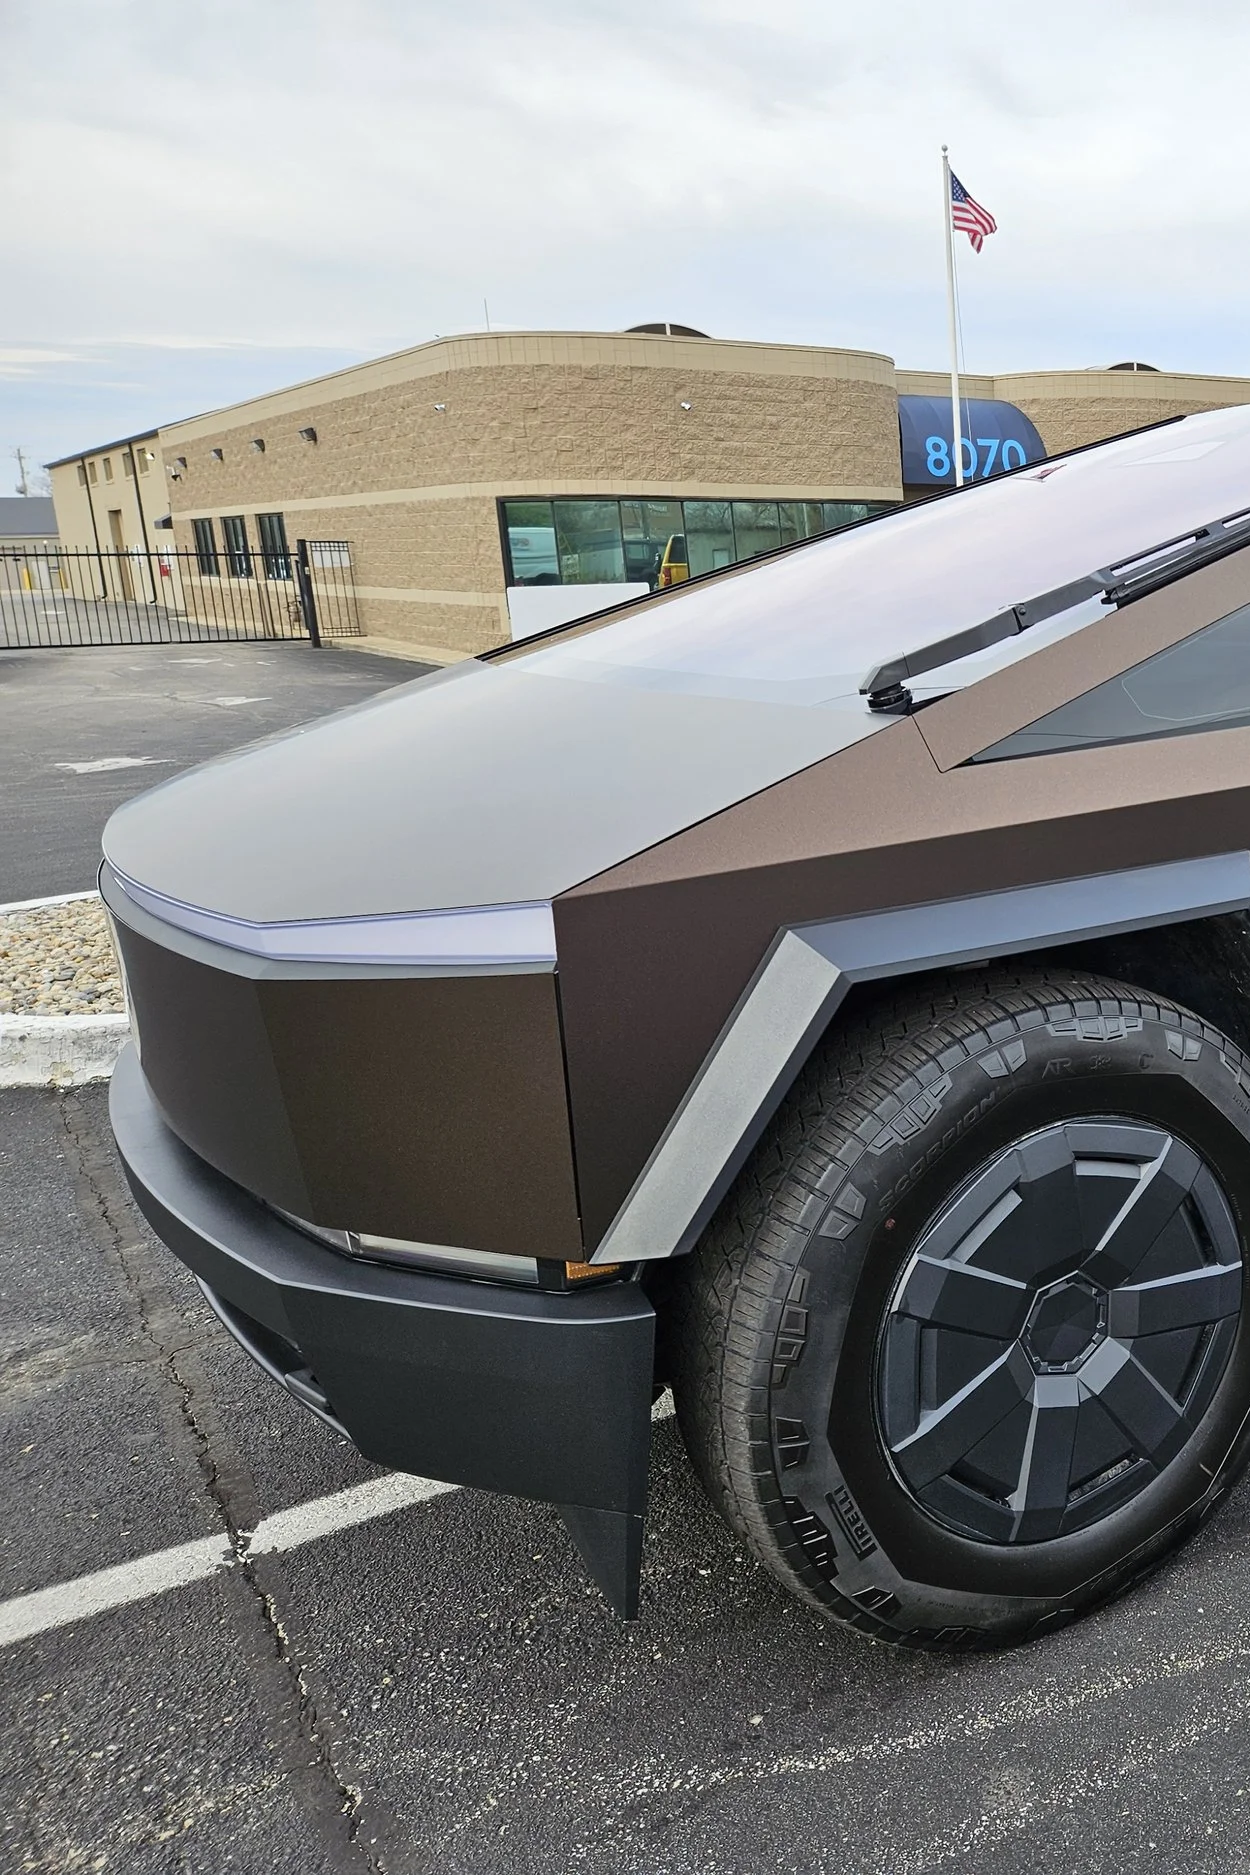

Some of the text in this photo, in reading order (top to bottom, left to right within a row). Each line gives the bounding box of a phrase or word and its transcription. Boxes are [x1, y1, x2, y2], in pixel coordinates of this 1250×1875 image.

[925, 436, 1027, 478] 8070
[879, 1090, 998, 1212] SCORPION
[824, 1484, 878, 1561] PIRELLI
